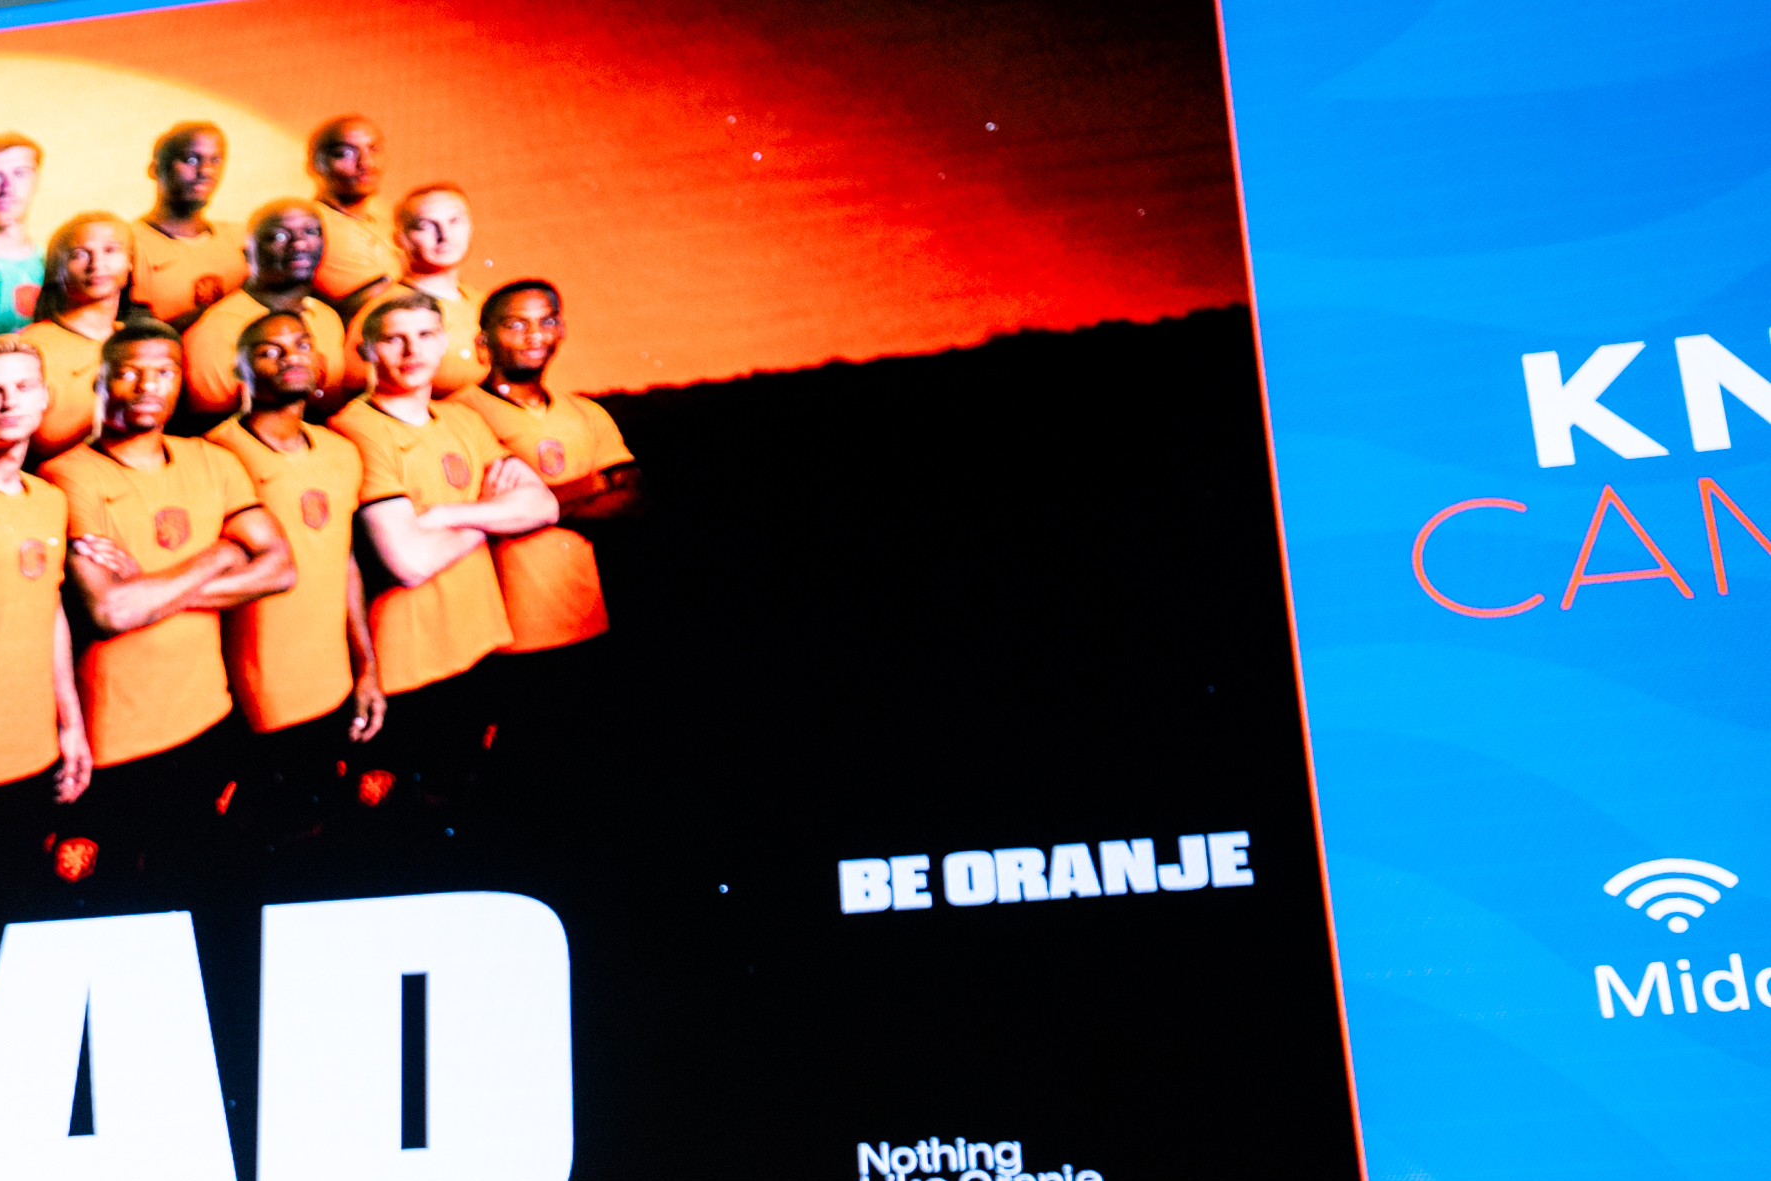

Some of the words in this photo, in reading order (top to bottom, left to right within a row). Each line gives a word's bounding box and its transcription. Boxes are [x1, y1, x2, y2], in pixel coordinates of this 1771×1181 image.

[838, 854, 933, 914] BE
[942, 831, 1254, 906] ORANJE
[857, 1136, 1023, 1176] Nothing
